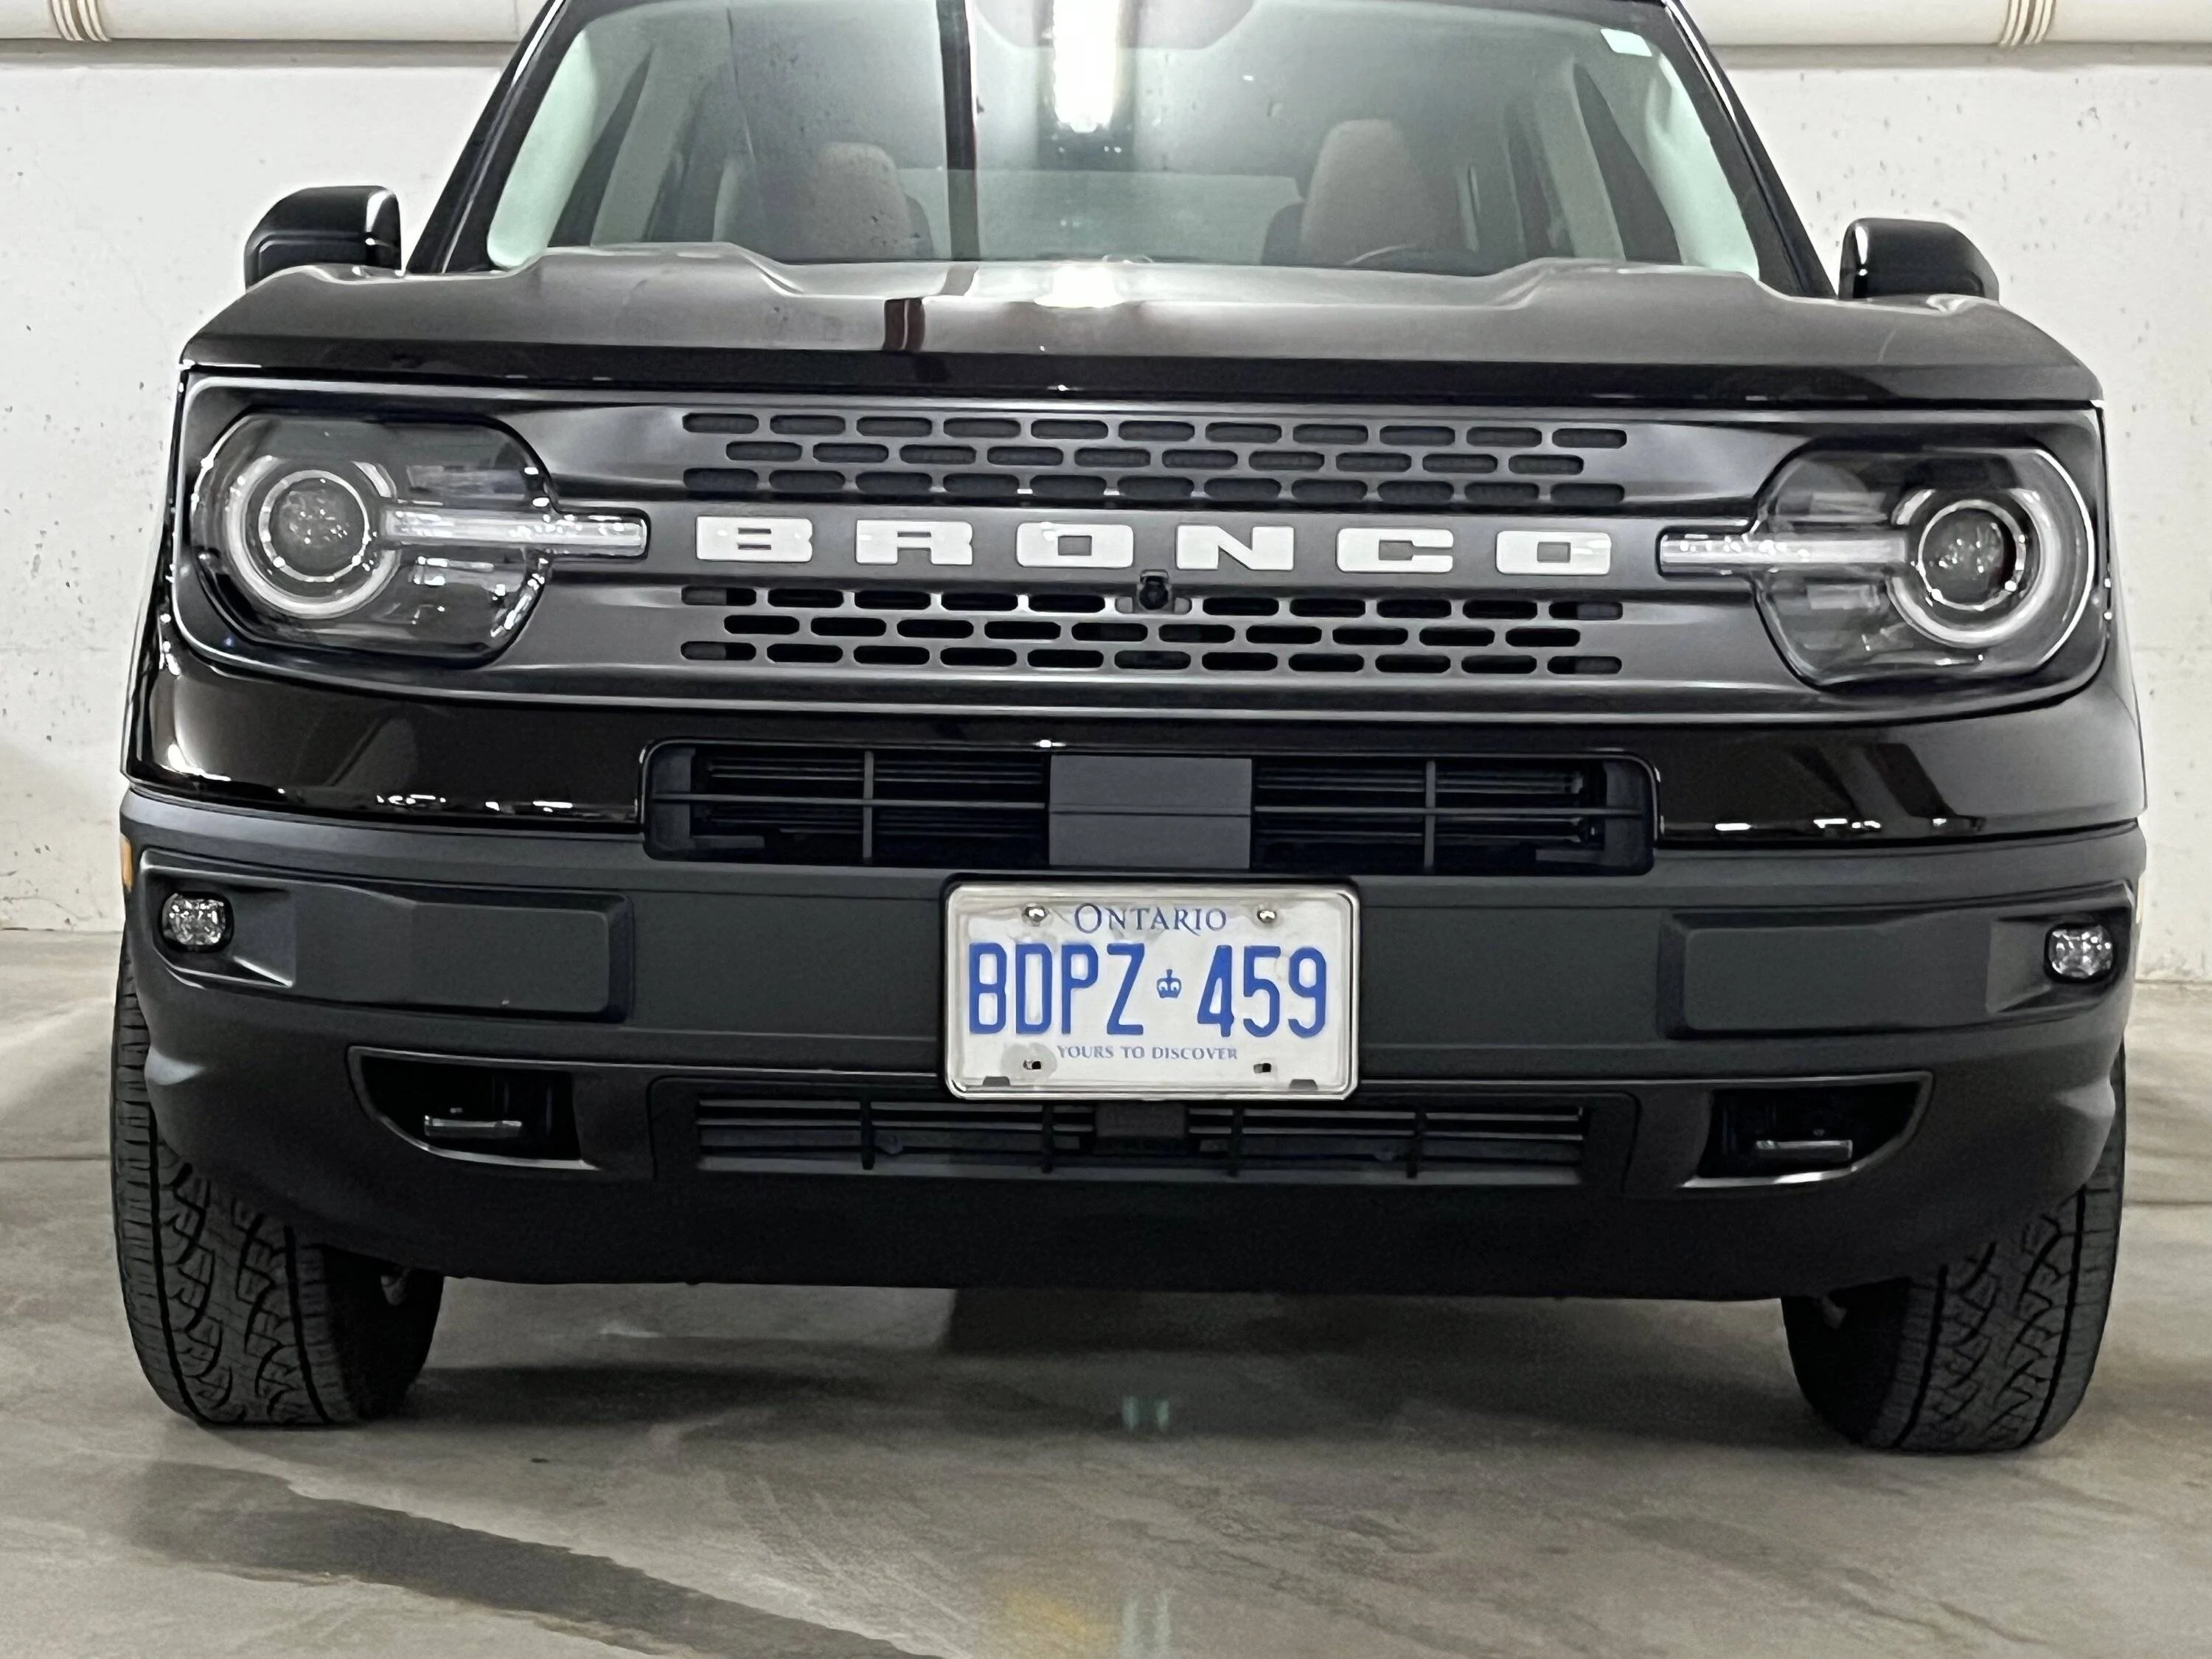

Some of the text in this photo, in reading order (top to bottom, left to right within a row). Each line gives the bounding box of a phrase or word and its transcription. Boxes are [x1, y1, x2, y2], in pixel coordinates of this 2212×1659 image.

[695, 515, 1613, 576] BRONCO
[1074, 902, 1227, 936] ONTARIO
[968, 942, 1327, 1038] BDPZ 459
[1057, 1044, 1238, 1061] YOURS TO DISCOVER
